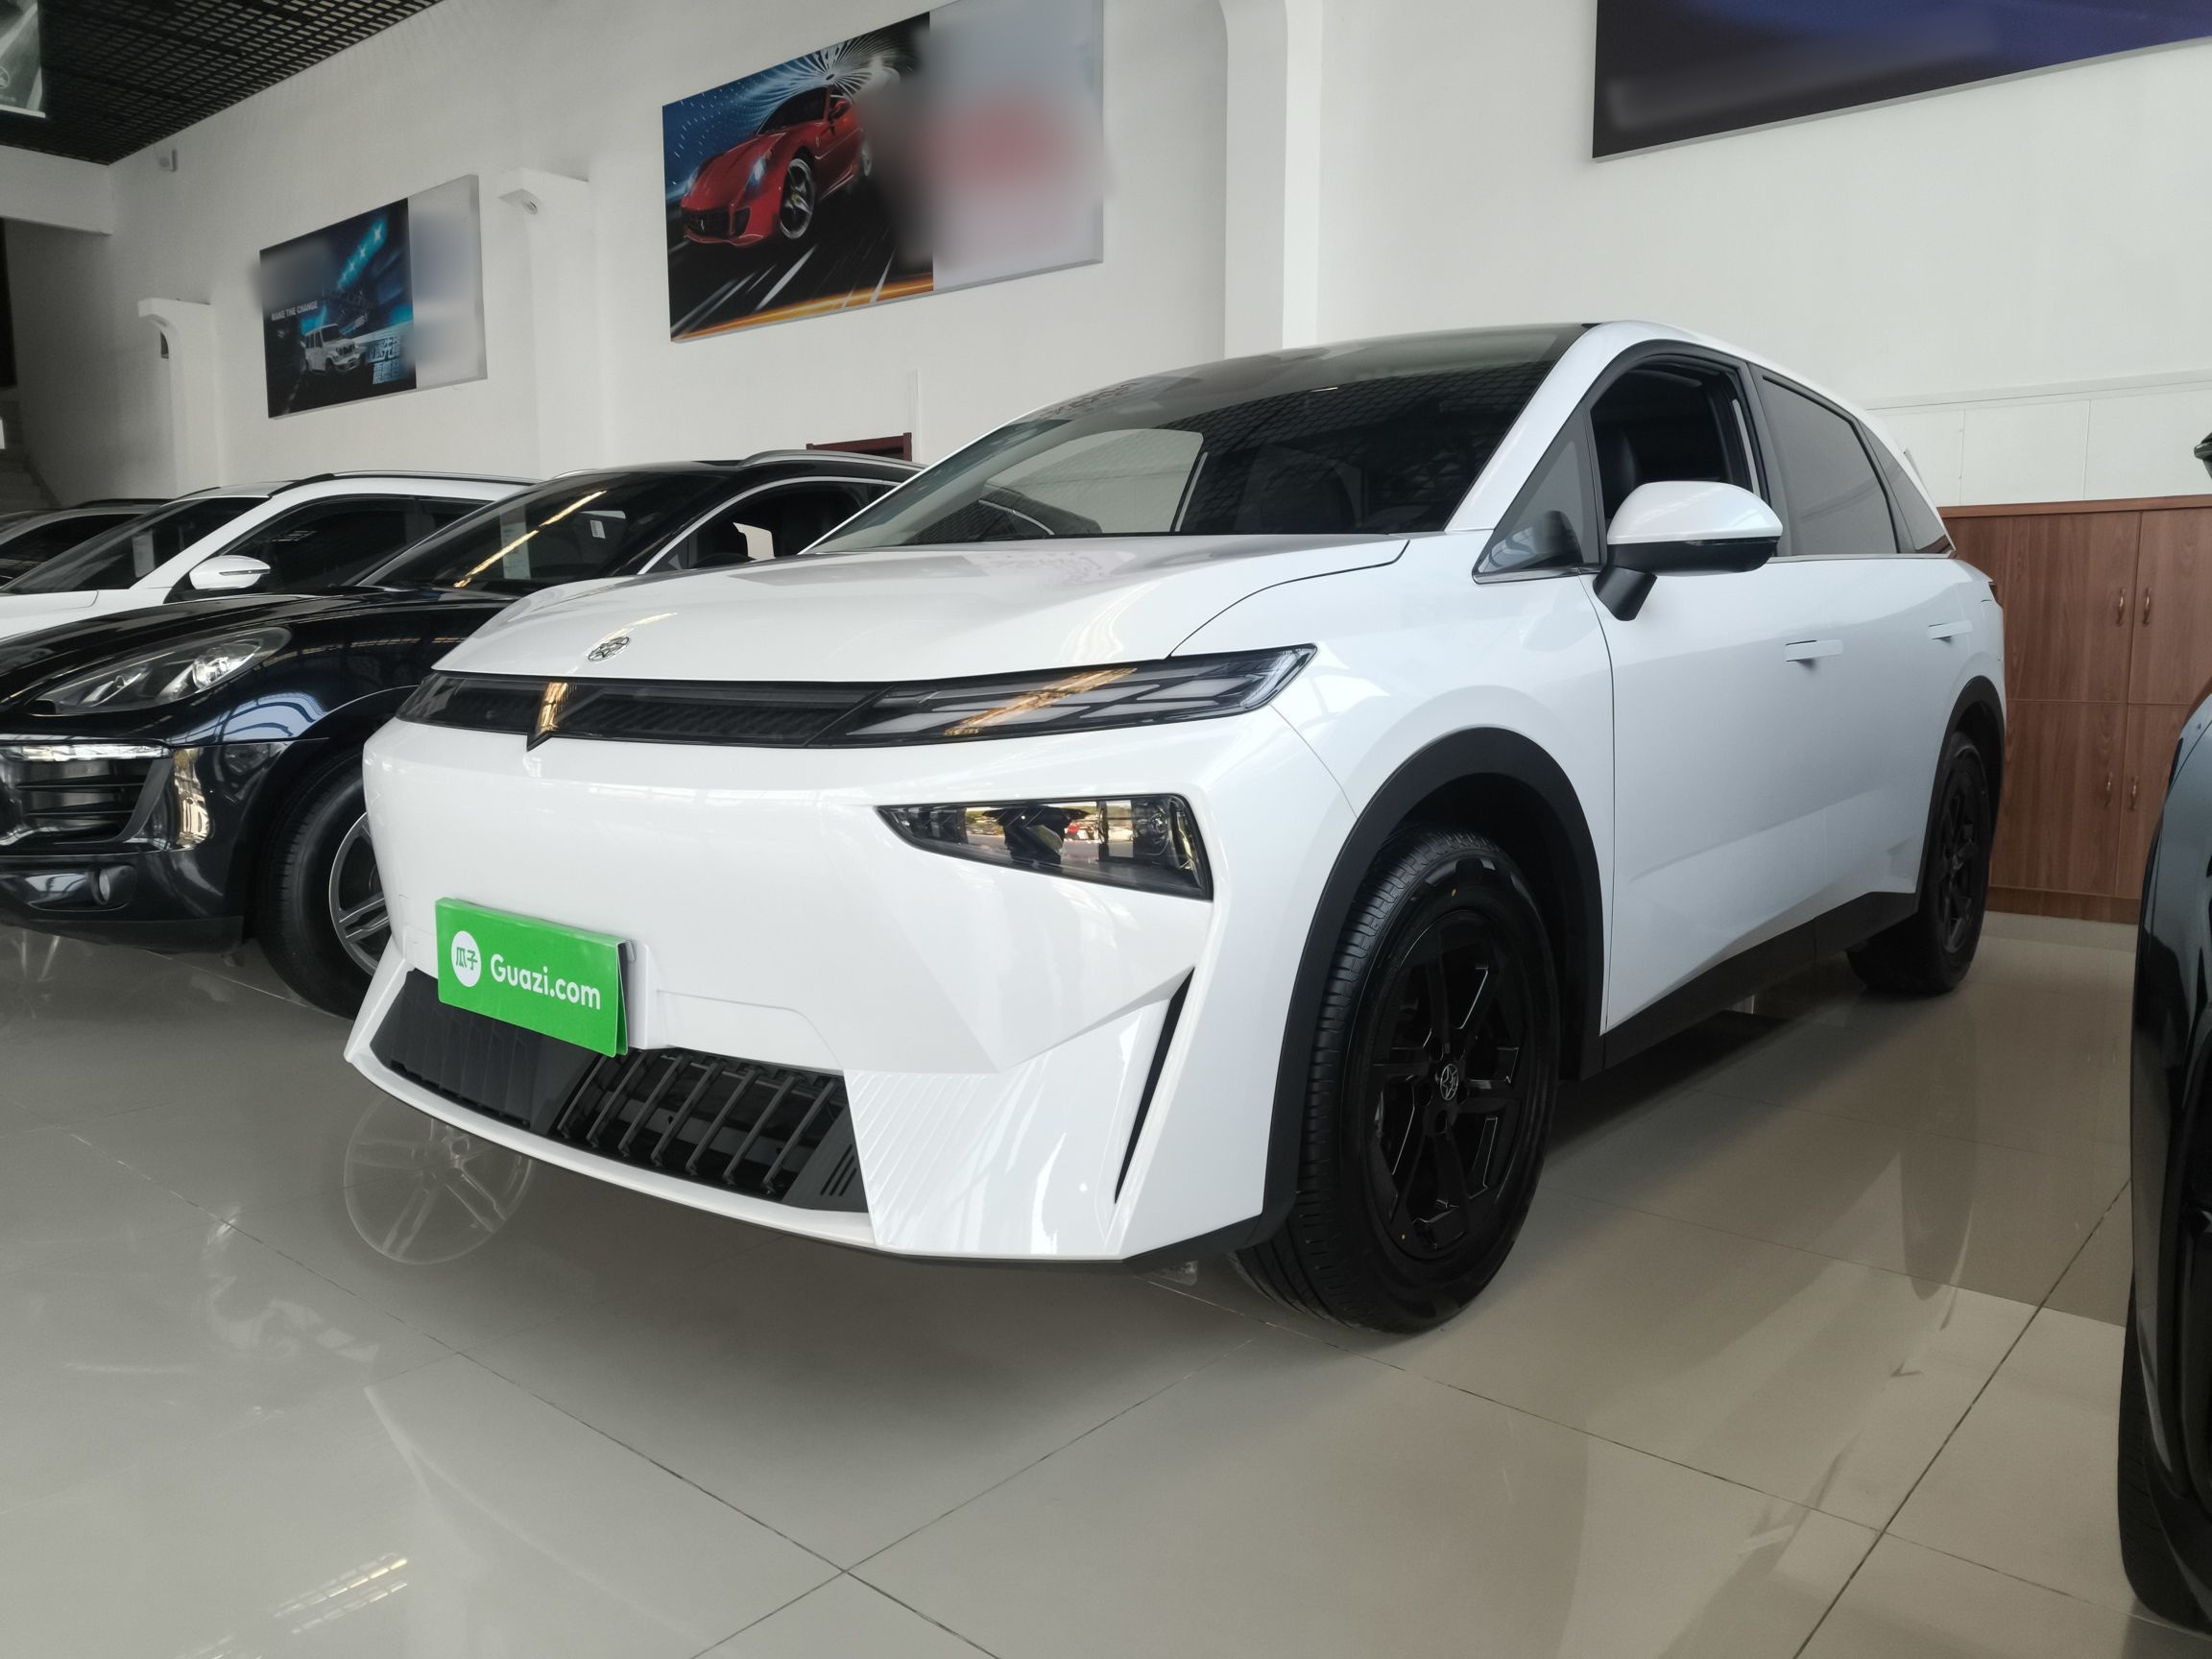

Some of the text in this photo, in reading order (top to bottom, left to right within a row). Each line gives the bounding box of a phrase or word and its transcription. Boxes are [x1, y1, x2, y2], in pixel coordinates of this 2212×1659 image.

[272, 301, 318, 322] MAKE THE CHANGE
[456, 947, 478, 971] 瓜子
[491, 953, 601, 1010] Guazi.com
